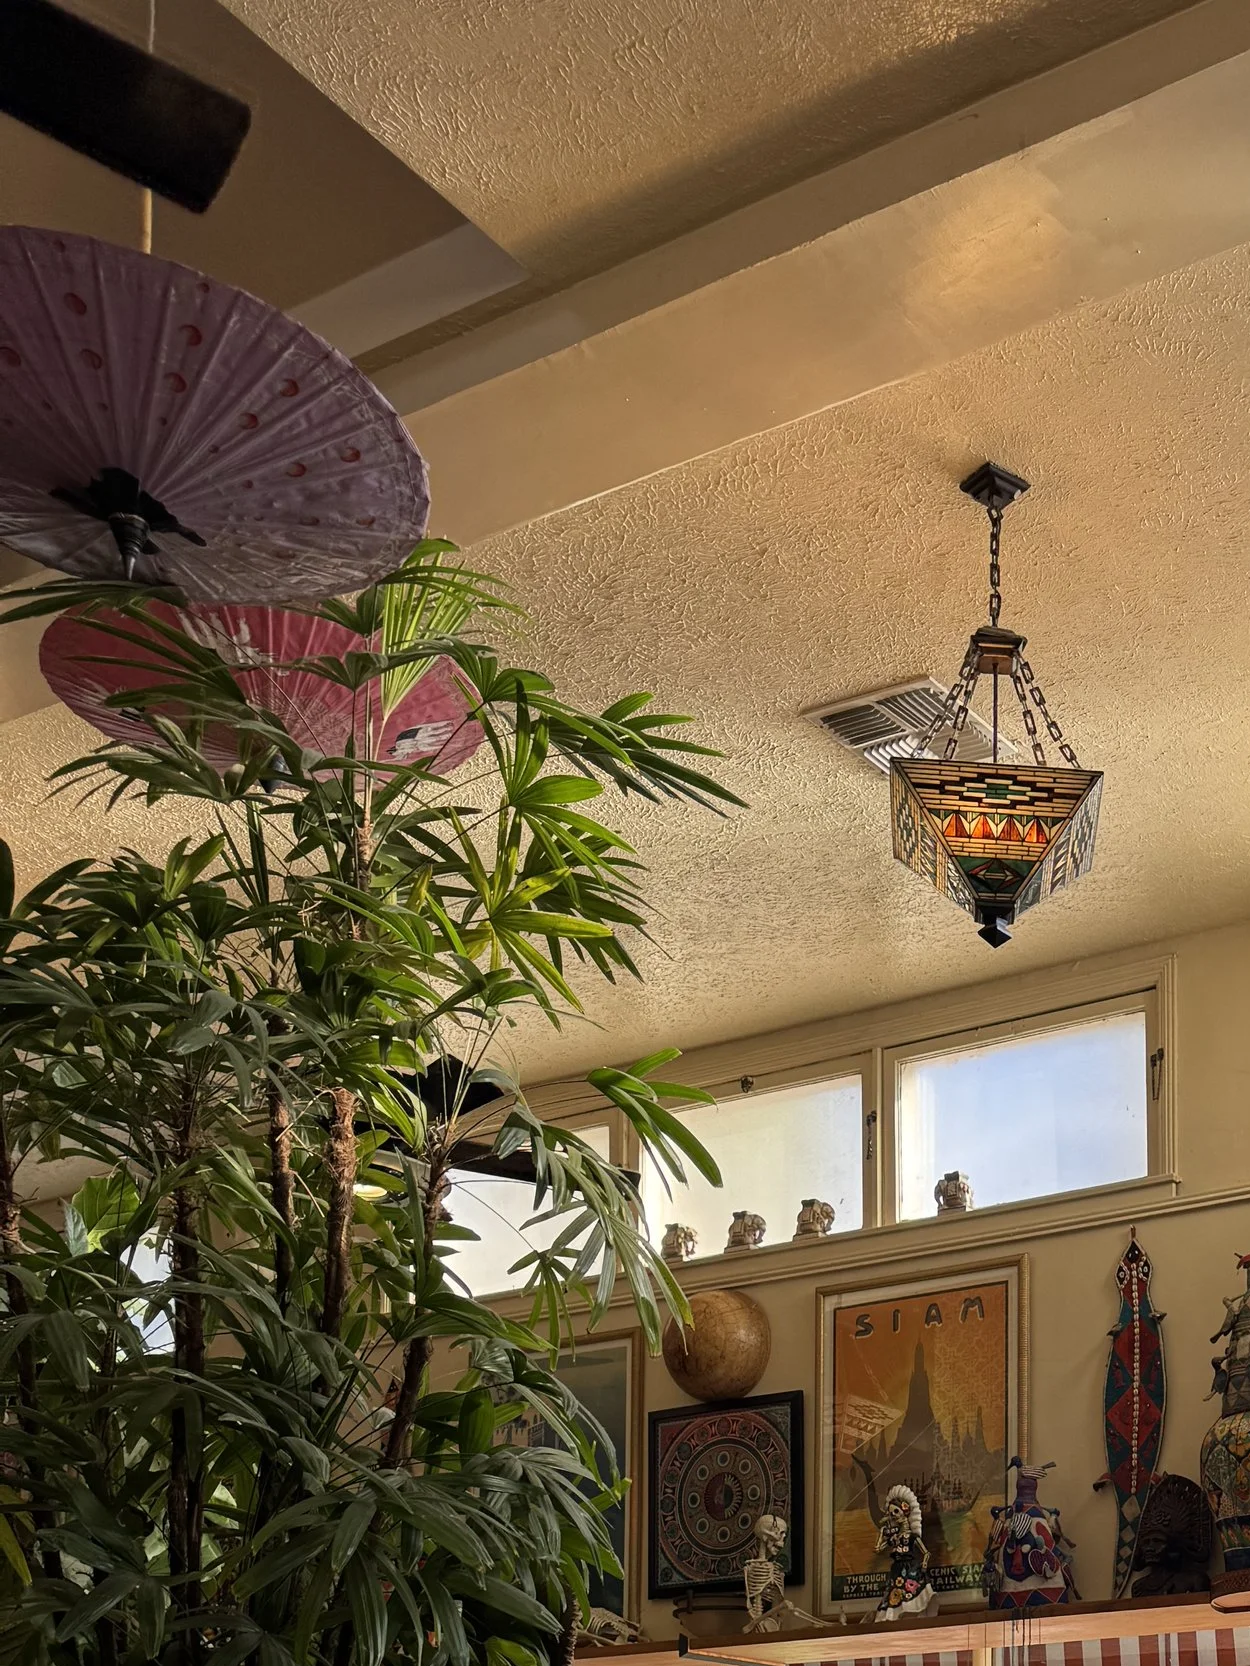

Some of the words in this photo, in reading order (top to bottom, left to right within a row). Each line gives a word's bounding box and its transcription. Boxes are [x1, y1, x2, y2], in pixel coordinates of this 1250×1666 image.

[853, 1295, 985, 1339] SIAM
[847, 1573, 887, 1584] THROUGH
[930, 1566, 956, 1577] CENIC
[843, 1584, 857, 1593] BY
[860, 1583, 879, 1591] THE
